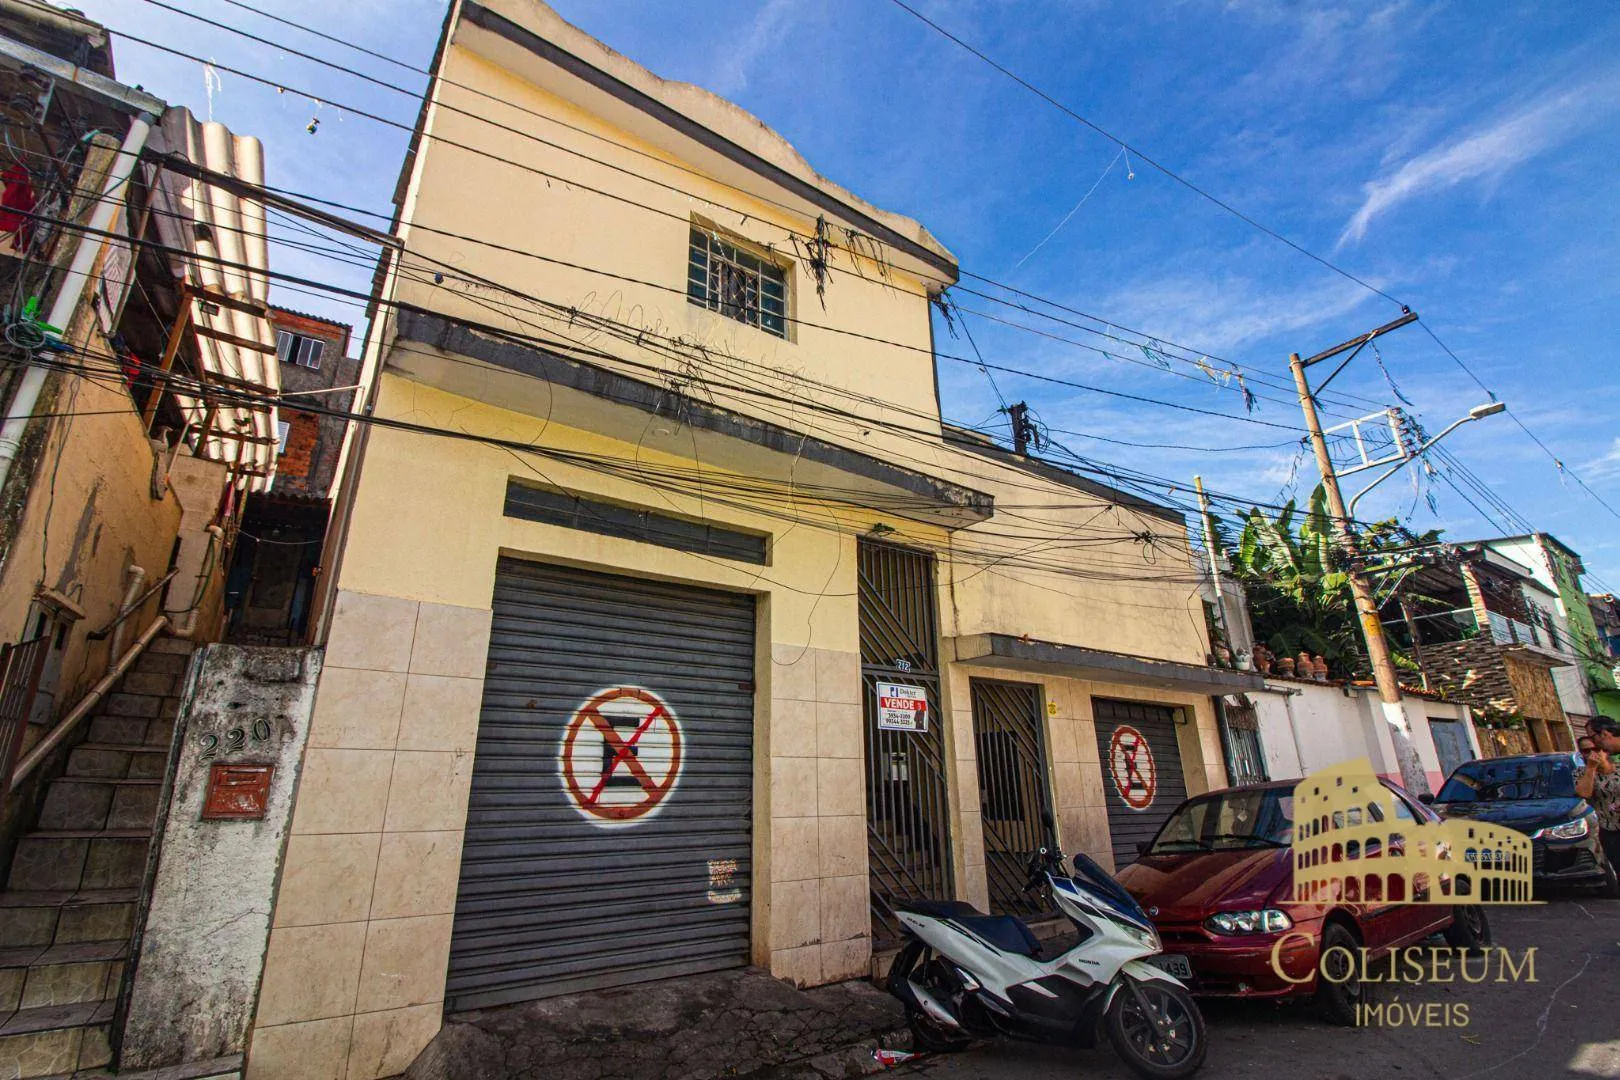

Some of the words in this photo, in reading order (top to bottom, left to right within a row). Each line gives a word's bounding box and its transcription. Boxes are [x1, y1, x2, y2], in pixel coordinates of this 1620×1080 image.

[897, 661, 909, 671] 212
[884, 698, 914, 710] VENDE
[199, 718, 271, 761] 220
